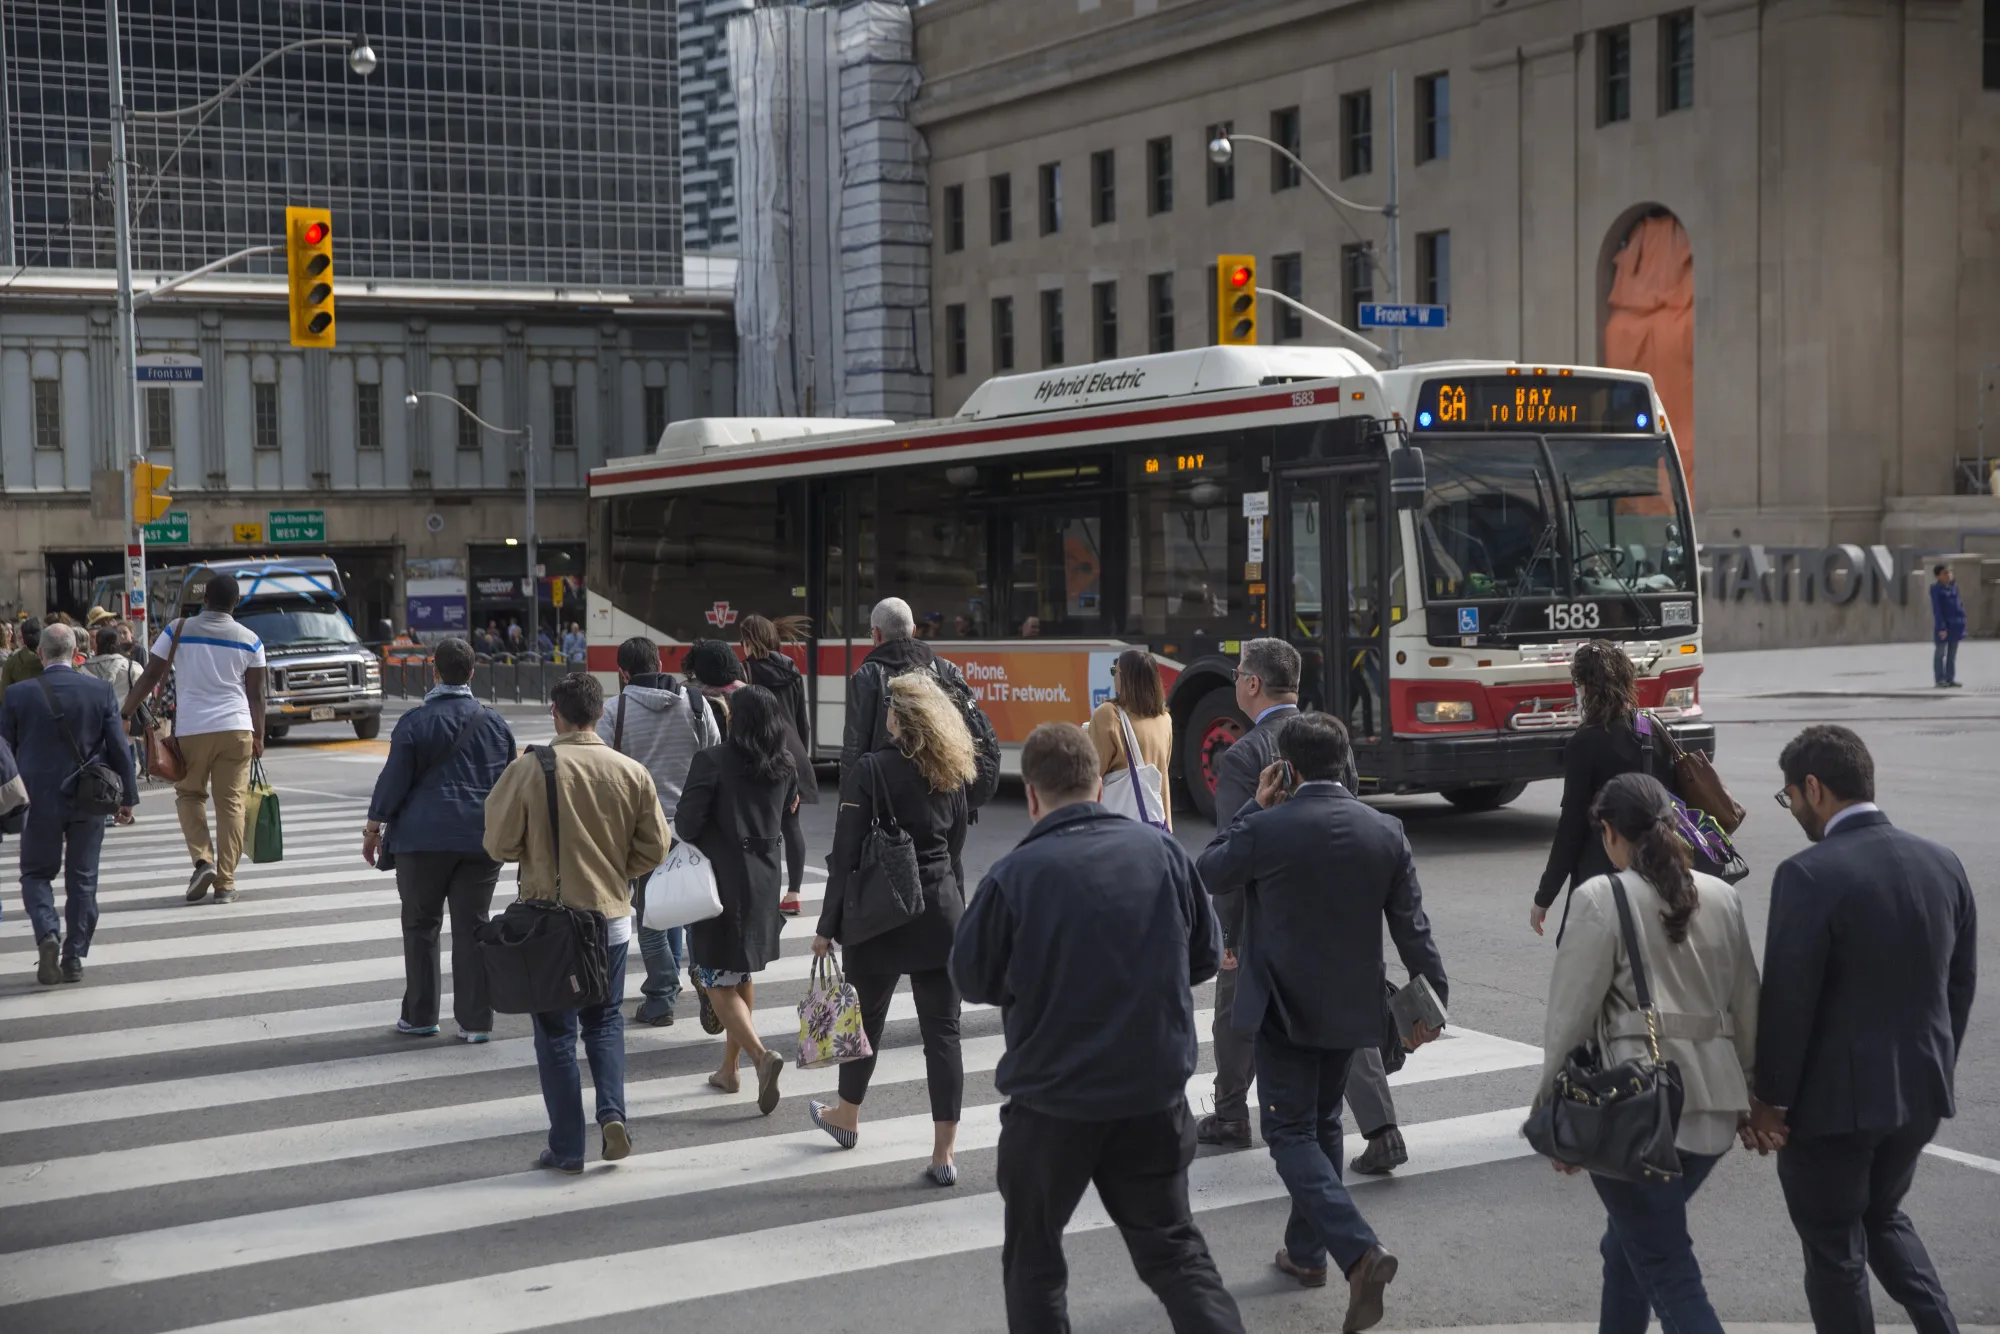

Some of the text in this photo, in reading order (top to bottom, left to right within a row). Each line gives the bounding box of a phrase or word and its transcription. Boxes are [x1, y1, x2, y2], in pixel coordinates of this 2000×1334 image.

[1375, 306, 1407, 324] Front
[1418, 307, 1430, 324] W
[148, 367, 174, 379] Front
[184, 367, 193, 379] W
[1034, 368, 1146, 403] Hybrid Electric
[1291, 391, 1315, 405] 1583
[1439, 385, 1552, 421] 6A BAY
[1491, 405, 1578, 422] TO DUPONT
[1178, 454, 1204, 471] BAY
[144, 529, 161, 540] AST
[276, 527, 300, 539] WEST
[1698, 544, 1909, 606] TATION
[1544, 602, 1600, 630] 1583
[966, 662, 1008, 680] Phone.
